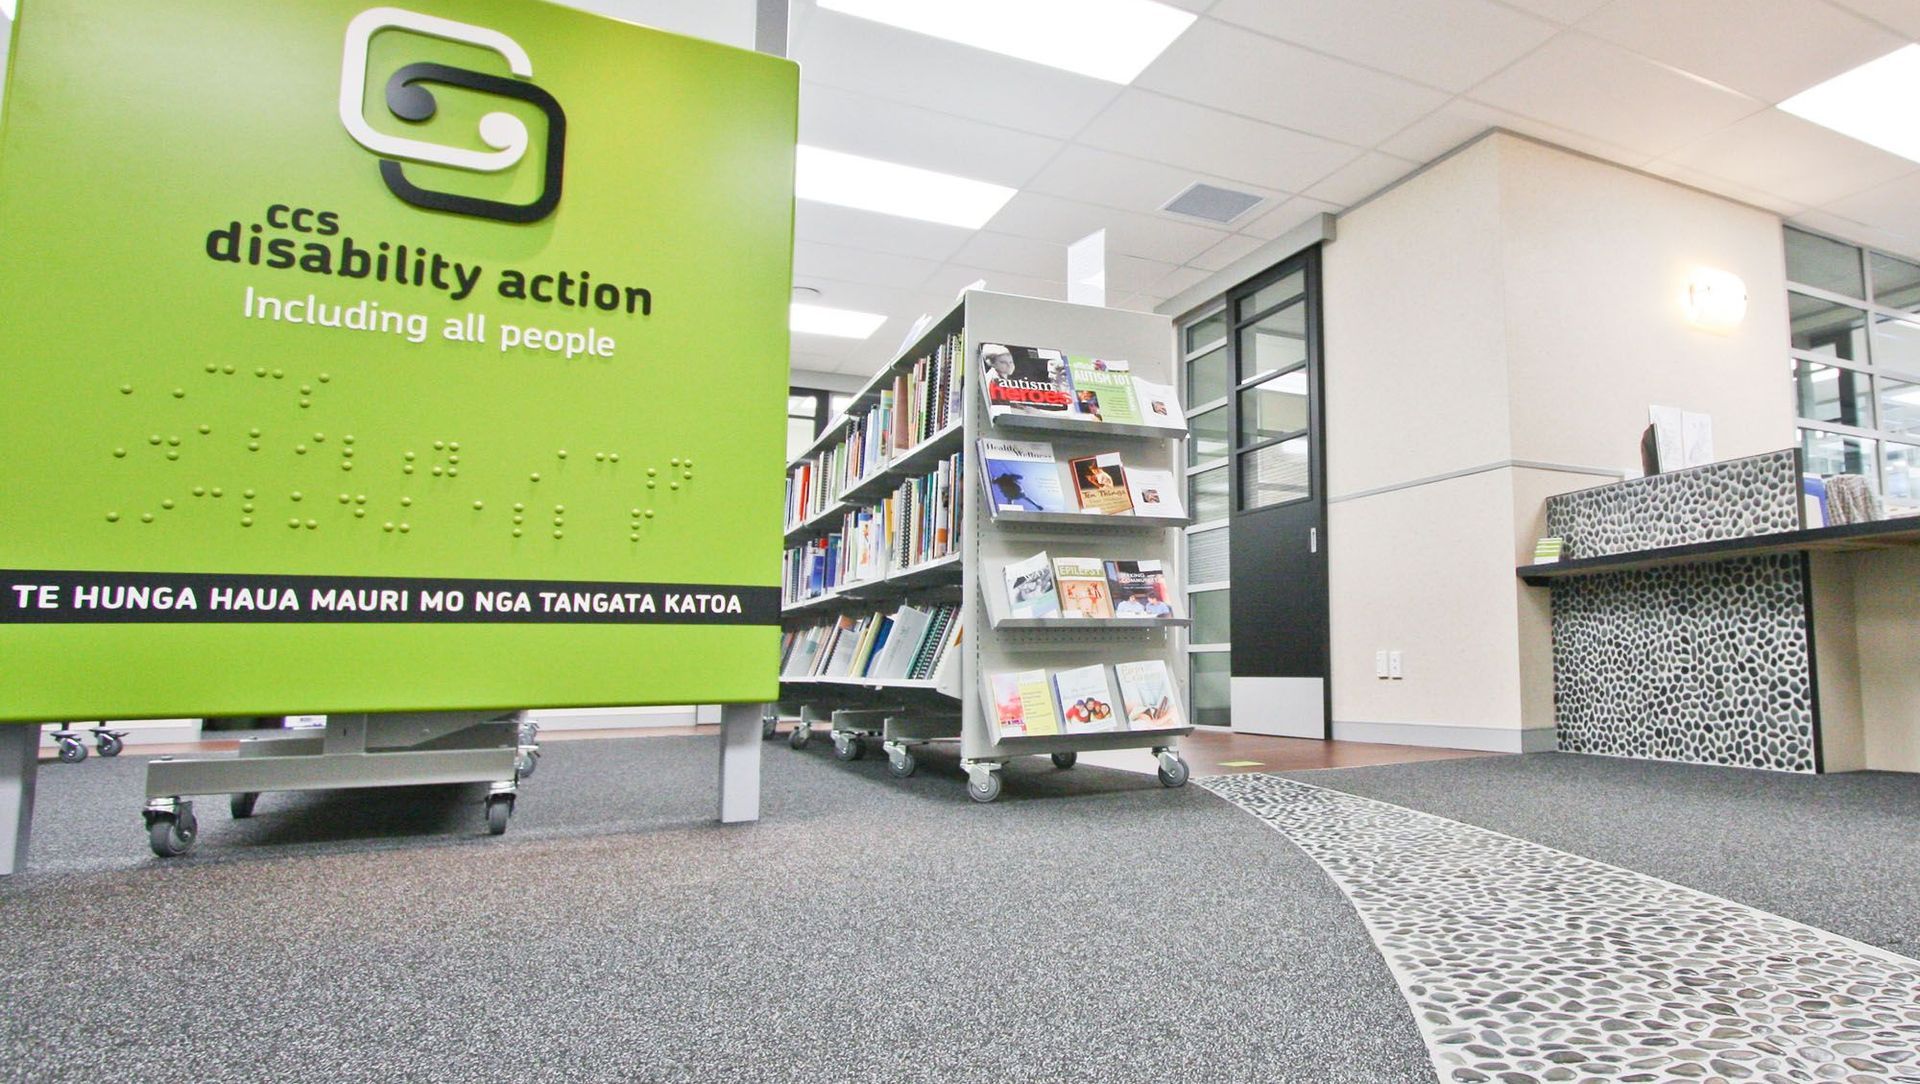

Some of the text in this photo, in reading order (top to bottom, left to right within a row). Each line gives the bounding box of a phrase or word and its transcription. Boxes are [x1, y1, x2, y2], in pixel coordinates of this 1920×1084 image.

[266, 204, 339, 236] ccs
[206, 221, 652, 316] disability action
[243, 286, 616, 360] Including all people
[990, 380, 1073, 404] heroes
[998, 377, 1055, 391] autism
[1074, 369, 1112, 385] AUTISM
[11, 584, 742, 614] TE HUNGA HAUA MAURI MO NGA TANGATA KATOA
